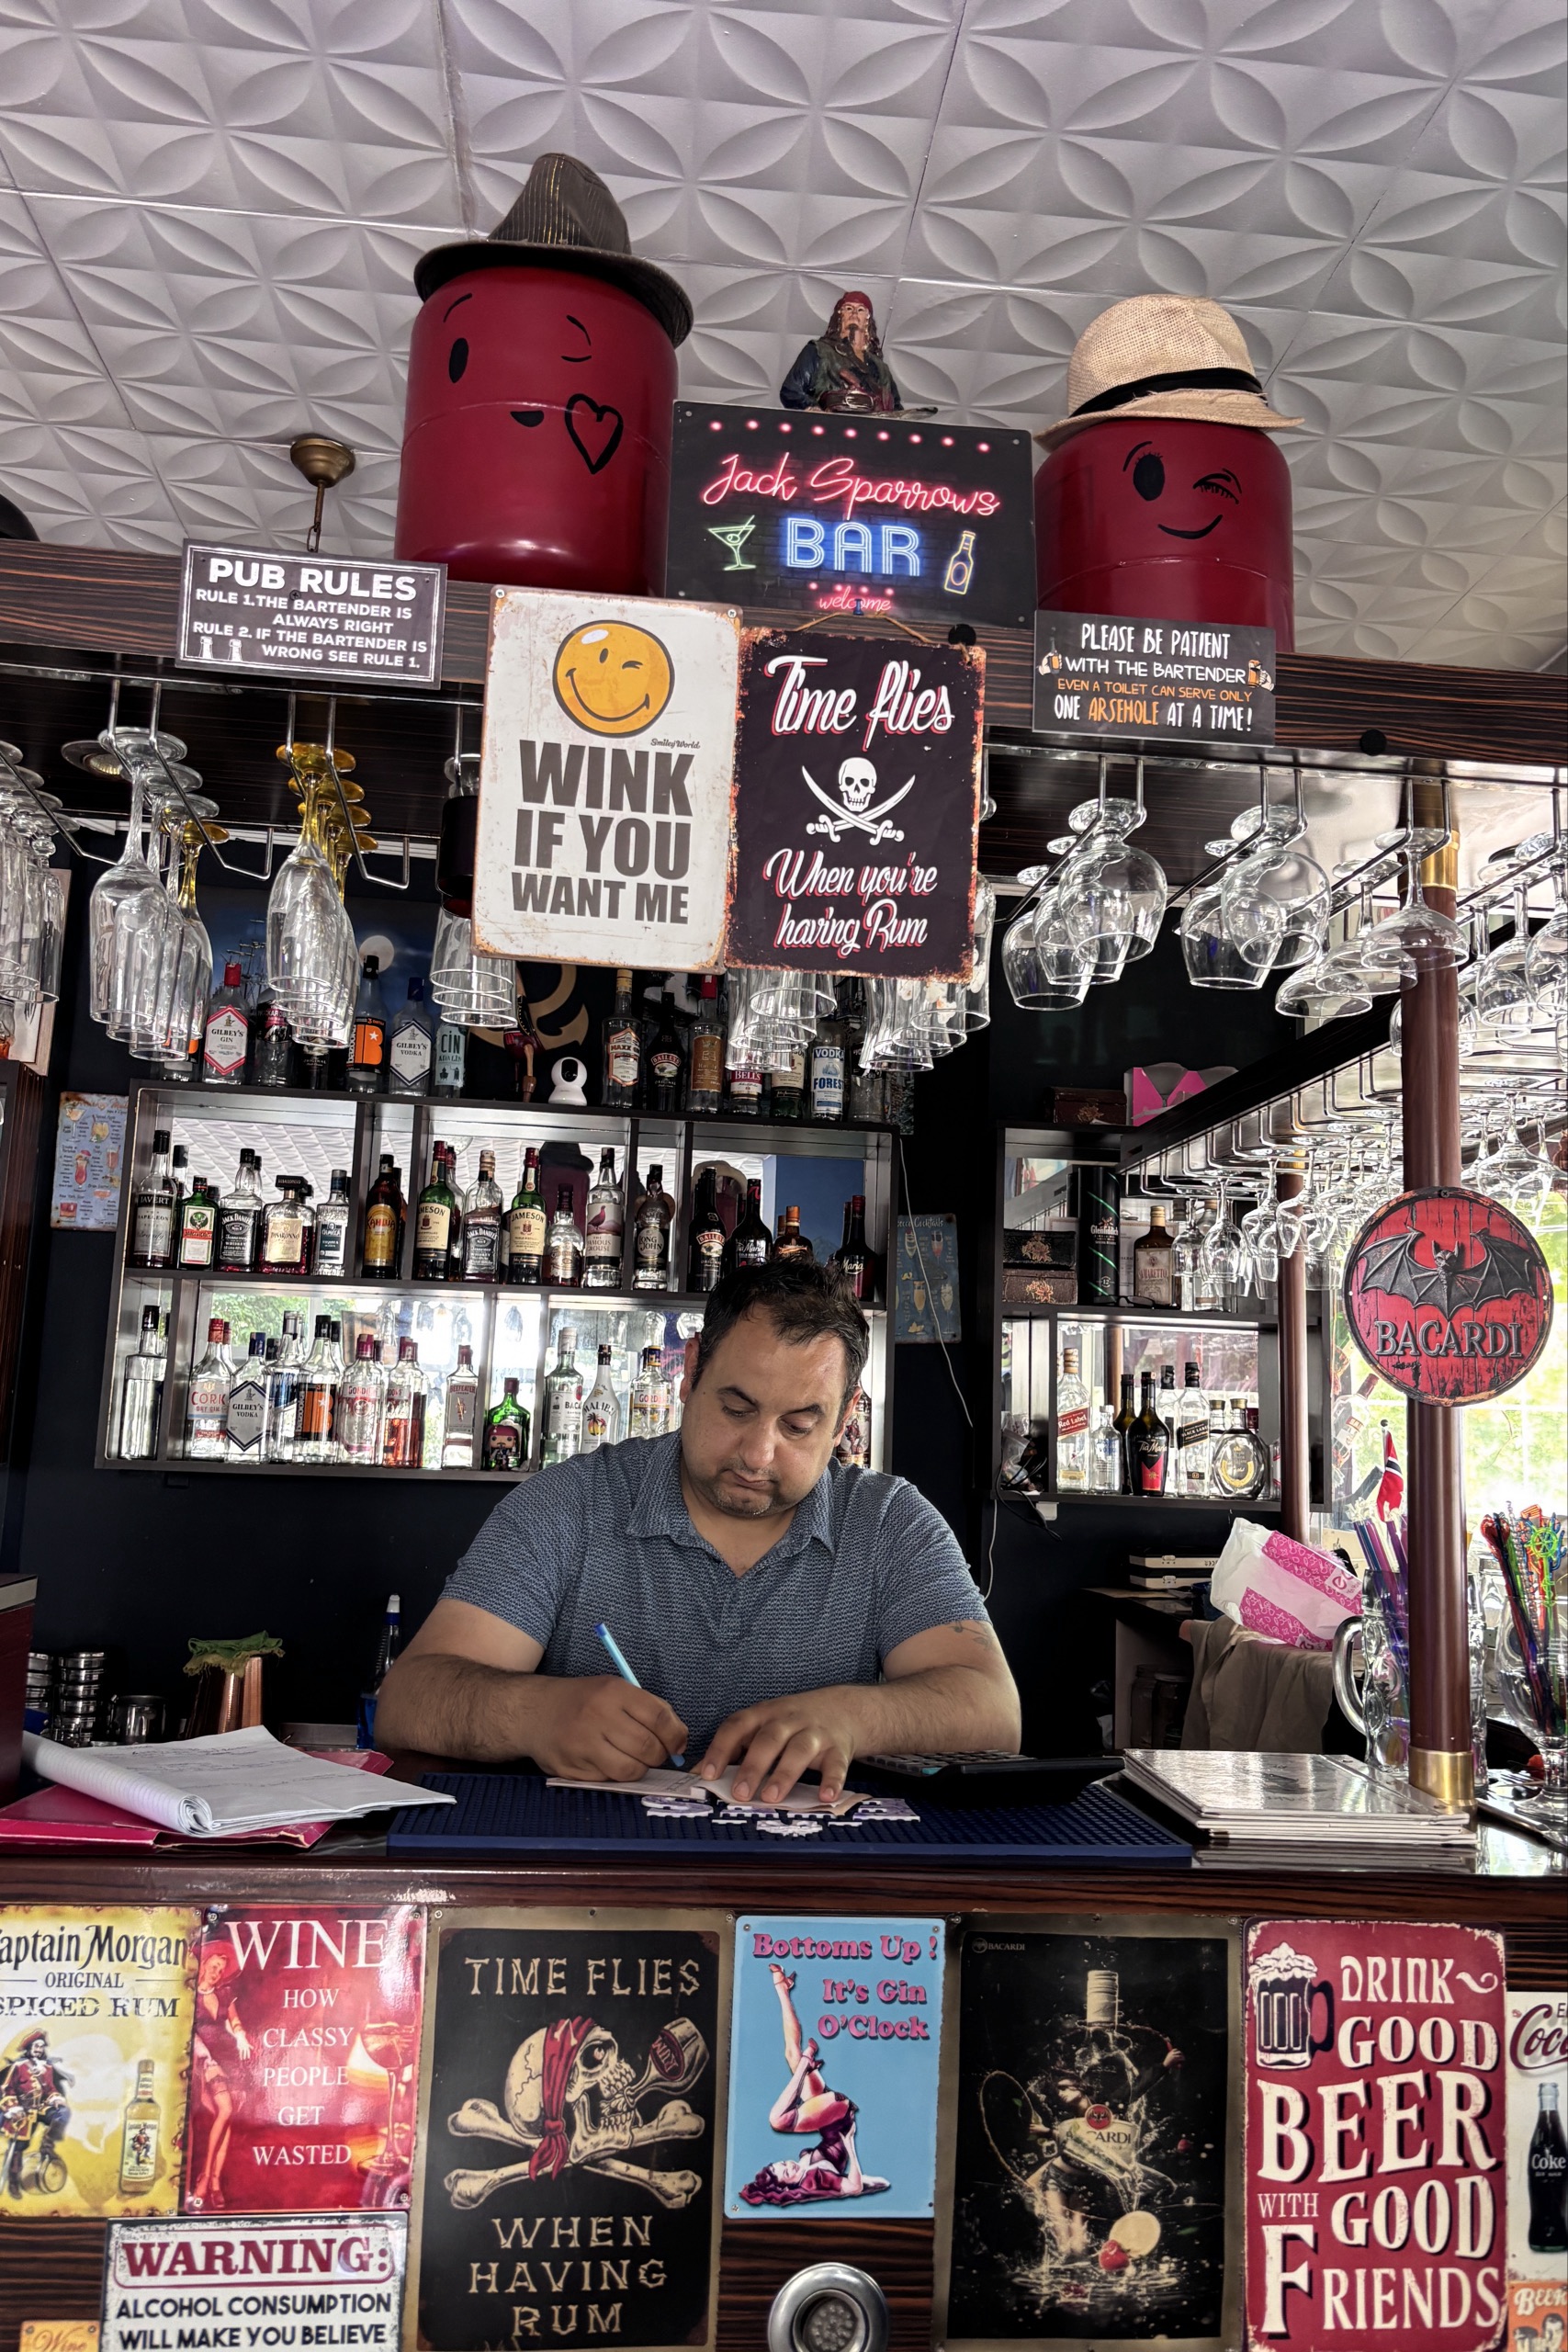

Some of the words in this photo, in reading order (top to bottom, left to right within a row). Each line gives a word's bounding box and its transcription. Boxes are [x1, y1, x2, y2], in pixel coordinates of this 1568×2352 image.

[703, 452, 797, 505] Jack
[810, 458, 999, 520] Sparrows
[786, 517, 919, 576] BAR
[209, 559, 285, 589] PUB
[299, 568, 417, 600] RULES
[196, 589, 238, 605] RULE
[294, 600, 391, 617] BARTENDER
[397, 607, 412, 619] IS
[193, 622, 233, 637] RULE
[238, 627, 253, 639] 2.
[256, 628, 271, 639] IF
[276, 630, 307, 643] THE
[313, 632, 410, 651] BARTENDER
[412, 640, 427, 652] IS
[273, 614, 339, 630] ALWAYS
[344, 620, 393, 634] RIGHT
[1081, 623, 1134, 652] PLEASE
[1143, 628, 1163, 655] BE
[1171, 629, 1230, 660] PATIENT
[262, 644, 322, 661] WRONG
[328, 650, 358, 663] SEE
[364, 653, 403, 667] RULE
[409, 657, 420, 668] 1.
[1066, 656, 1109, 674] WITH
[1115, 660, 1147, 677] THE
[1154, 662, 1246, 684] BARTENDER
[763, 654, 858, 736] Time
[861, 660, 955, 752] flies
[1058, 678, 1089, 691] EVEN
[1092, 681, 1100, 692] A
[1104, 681, 1145, 695] TOILET
[1151, 684, 1175, 696] CAN
[1179, 687, 1216, 700] SERVE
[1220, 690, 1253, 702] ONLY
[1055, 695, 1080, 720] ONE
[1088, 696, 1159, 726] ARSEHOLE
[1167, 702, 1185, 727] AT
[1192, 704, 1201, 728] A
[1210, 705, 1253, 731] TIME!
[518, 739, 695, 817] WINK
[513, 808, 563, 869] IF
[577, 814, 692, 880] YOU
[763, 847, 855, 899] When
[857, 852, 938, 906] you're
[511, 871, 628, 919] WANT
[635, 882, 690, 925] ME
[773, 901, 862, 958] having
[865, 899, 928, 952] Rum
[211, 1028, 243, 1037] GILBEY'S
[653, 1054, 680, 1064] BAILEYS
[815, 1049, 844, 1057] VODKA
[735, 1070, 761, 1081] BELL'S
[814, 1078, 844, 1090] FOREST
[512, 1212, 545, 1223] JAMESON
[638, 1236, 658, 1245] LONG
[842, 1258, 863, 1272] Maria
[1374, 1320, 1523, 1358] BACARDI
[191, 1391, 226, 1406] CORK
[232, 1403, 264, 1411] GILBEY'S
[1058, 1419, 1070, 1429] Red
[1070, 1415, 1087, 1425] Label
[0, 1925, 81, 1970] aptain
[78, 1925, 187, 1971] Morgan
[225, 1919, 389, 1970] WINE
[753, 1933, 872, 1959] Bottoms
[987, 1942, 1025, 1951] BACARDI
[45, 1972, 124, 1988] ORIGINAL
[464, 1957, 568, 1996] TIME
[586, 1958, 701, 1996] FLIES
[1340, 1955, 1455, 2005] DRINK
[282, 1988, 339, 2008] HOW
[822, 1979, 869, 2004] It's
[876, 1980, 927, 2004] Gin
[107, 1997, 180, 2018] RUM
[263, 2027, 354, 2049] CLASSY
[818, 2014, 931, 2041] O'Clock
[1337, 2016, 1500, 2073] GOOD
[263, 2066, 350, 2086] PEOPLE
[277, 2106, 324, 2125] GET
[1257, 2069, 1497, 2185] BEER
[253, 2145, 352, 2165] WASTED
[1531, 2150, 1566, 2170] Coke
[1258, 2192, 1319, 2219] WITH
[1330, 2174, 1495, 2260] GOOD
[491, 2215, 653, 2250] WHEN
[122, 2235, 390, 2277] WARNING:
[468, 2258, 668, 2293] HAVING
[1260, 2224, 1501, 2334] FRIENDS
[116, 2295, 223, 2320] ALCOHOL
[228, 2293, 392, 2316] CONSUMPTION
[512, 2302, 624, 2337] RUM
[118, 2327, 177, 2350] WILL
[181, 2326, 243, 2349] MAKE
[246, 2324, 299, 2346] YOU
[301, 2324, 387, 2345] BELIEVE
